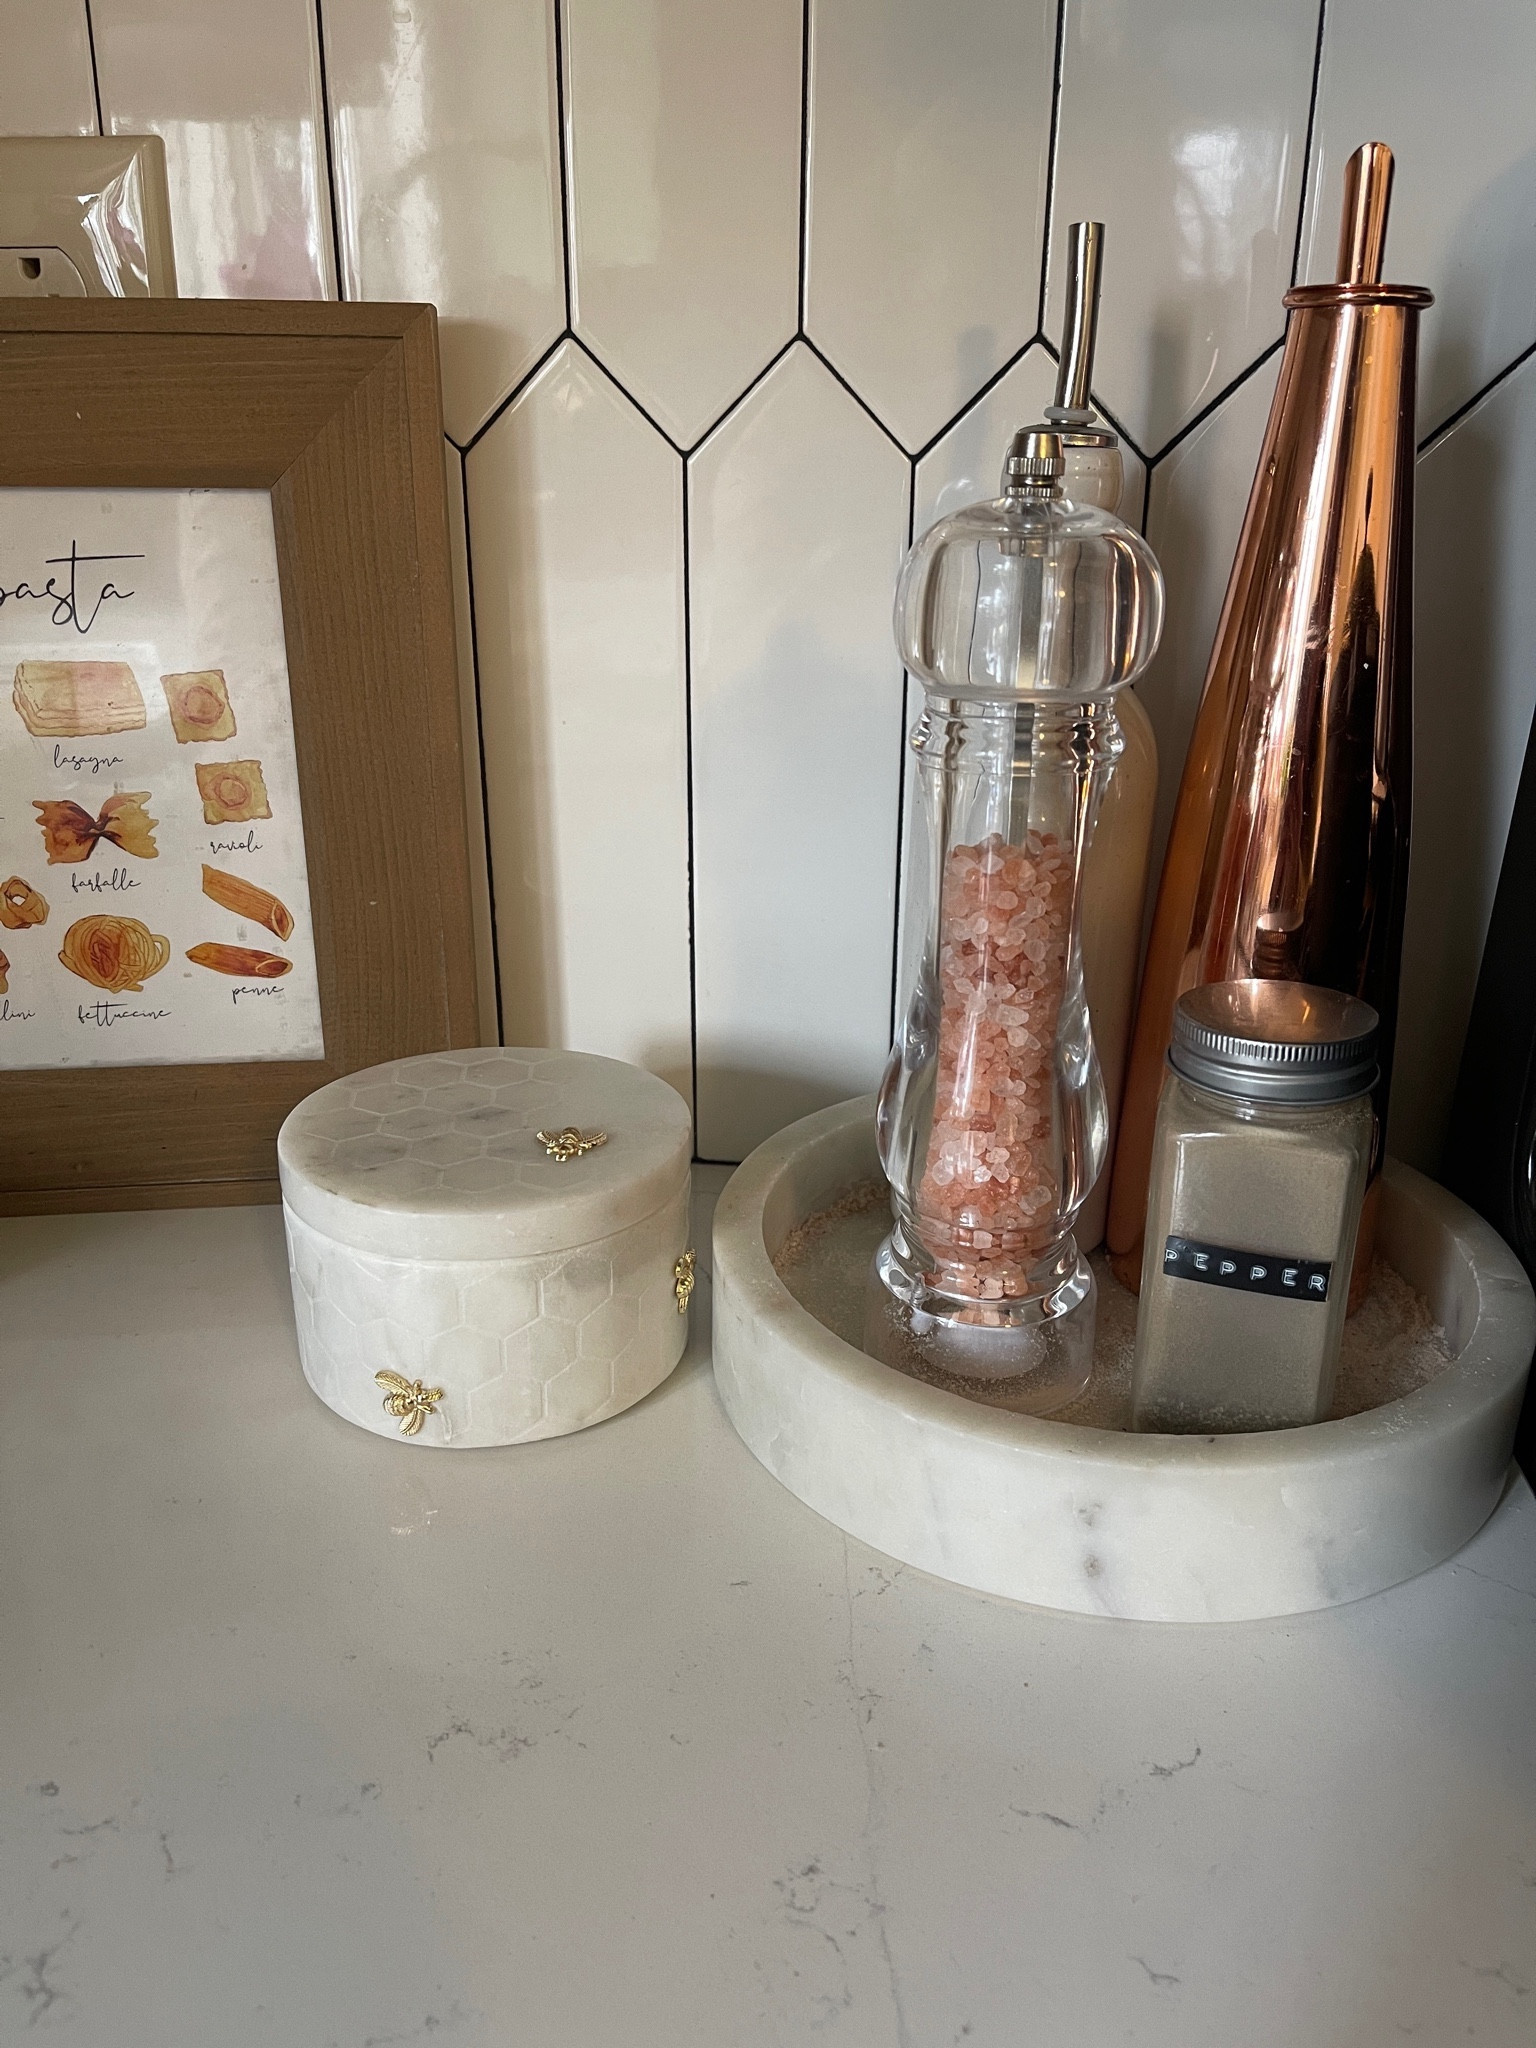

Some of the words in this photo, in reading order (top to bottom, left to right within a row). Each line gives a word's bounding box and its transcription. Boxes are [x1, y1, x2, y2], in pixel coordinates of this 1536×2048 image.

[53, 744, 124, 774] lasagna
[209, 830, 264, 854] ravioli
[71, 867, 142, 893] farfalle
[231, 983, 285, 1005] penne
[0, 999, 36, 1021] lini
[78, 1000, 172, 1027] fettuccine
[1163, 1247, 1328, 1293] PEPPER
